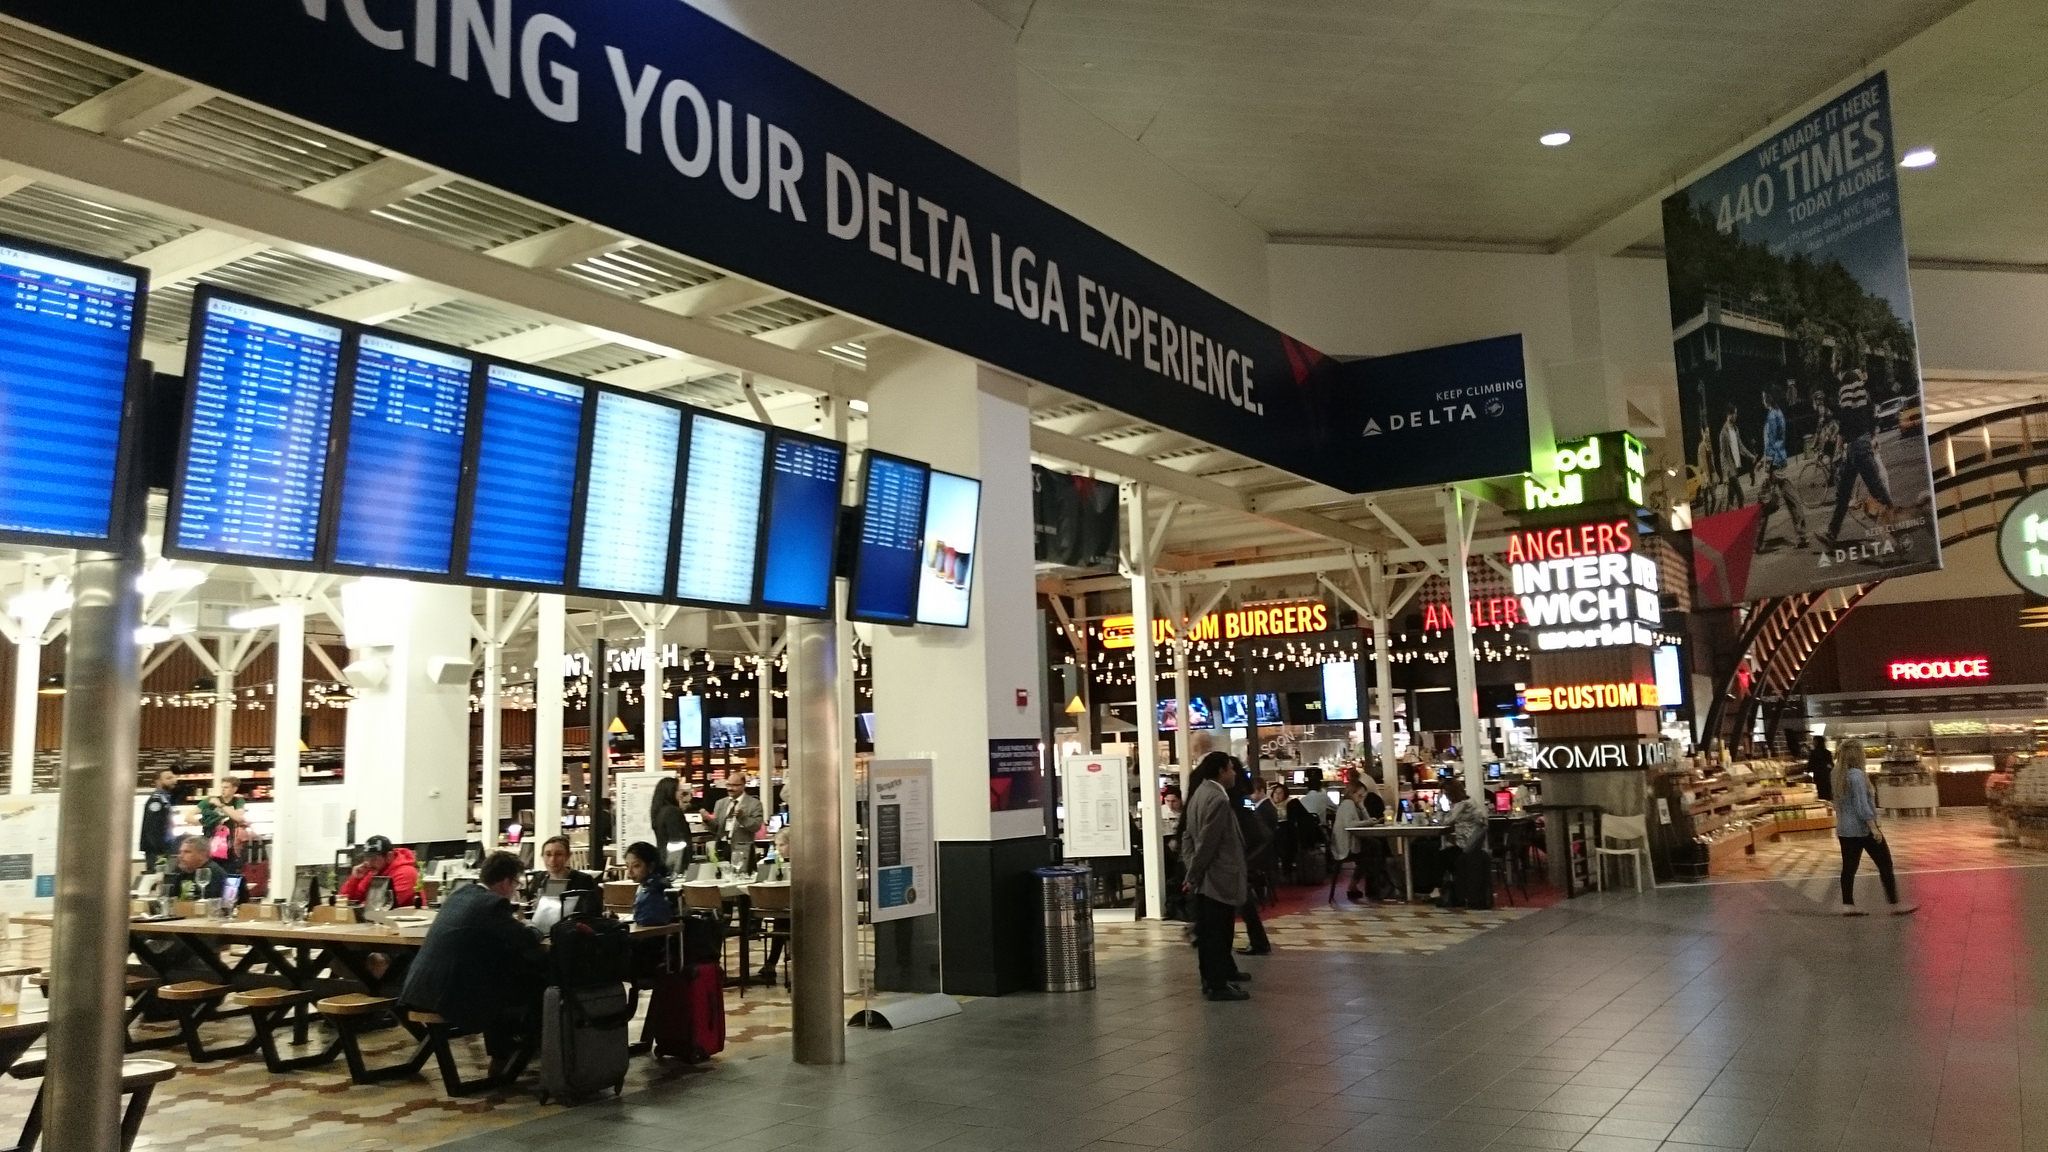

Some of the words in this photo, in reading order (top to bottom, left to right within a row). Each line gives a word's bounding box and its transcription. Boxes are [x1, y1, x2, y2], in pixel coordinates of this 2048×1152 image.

[1758, 143, 1780, 169] WE
[1781, 117, 1823, 156] MADE
[1825, 107, 1839, 131] IT
[1841, 84, 1881, 121] HERE
[1716, 173, 1774, 235] 440
[1779, 111, 1885, 202] TIMES
[1787, 186, 1834, 225] TODAY
[1838, 161, 1891, 201] ALONE.
[303, 0, 579, 123] ING
[605, 45, 807, 222] YOUR
[826, 152, 981, 295] DELTA
[991, 232, 1069, 333] LGA
[1078, 275, 1264, 416] EXPERIENCE.
[1436, 388, 1463, 401] KEEP
[1466, 379, 1524, 397] CLIMBING
[1389, 403, 1477, 431] DELTA
[1554, 436, 1602, 473] od
[1508, 521, 1632, 565] ANGLERS
[1835, 539, 1895, 564] DELTA
[1512, 553, 1631, 595] INTER
[1152, 614, 1220, 645] USOM
[1225, 604, 1328, 639] BURGERS
[1424, 597, 1529, 632] ANLER
[1521, 587, 1628, 627] WICH
[1889, 659, 1990, 681] PRODUCE
[1553, 682, 1639, 711] CUSTOM
